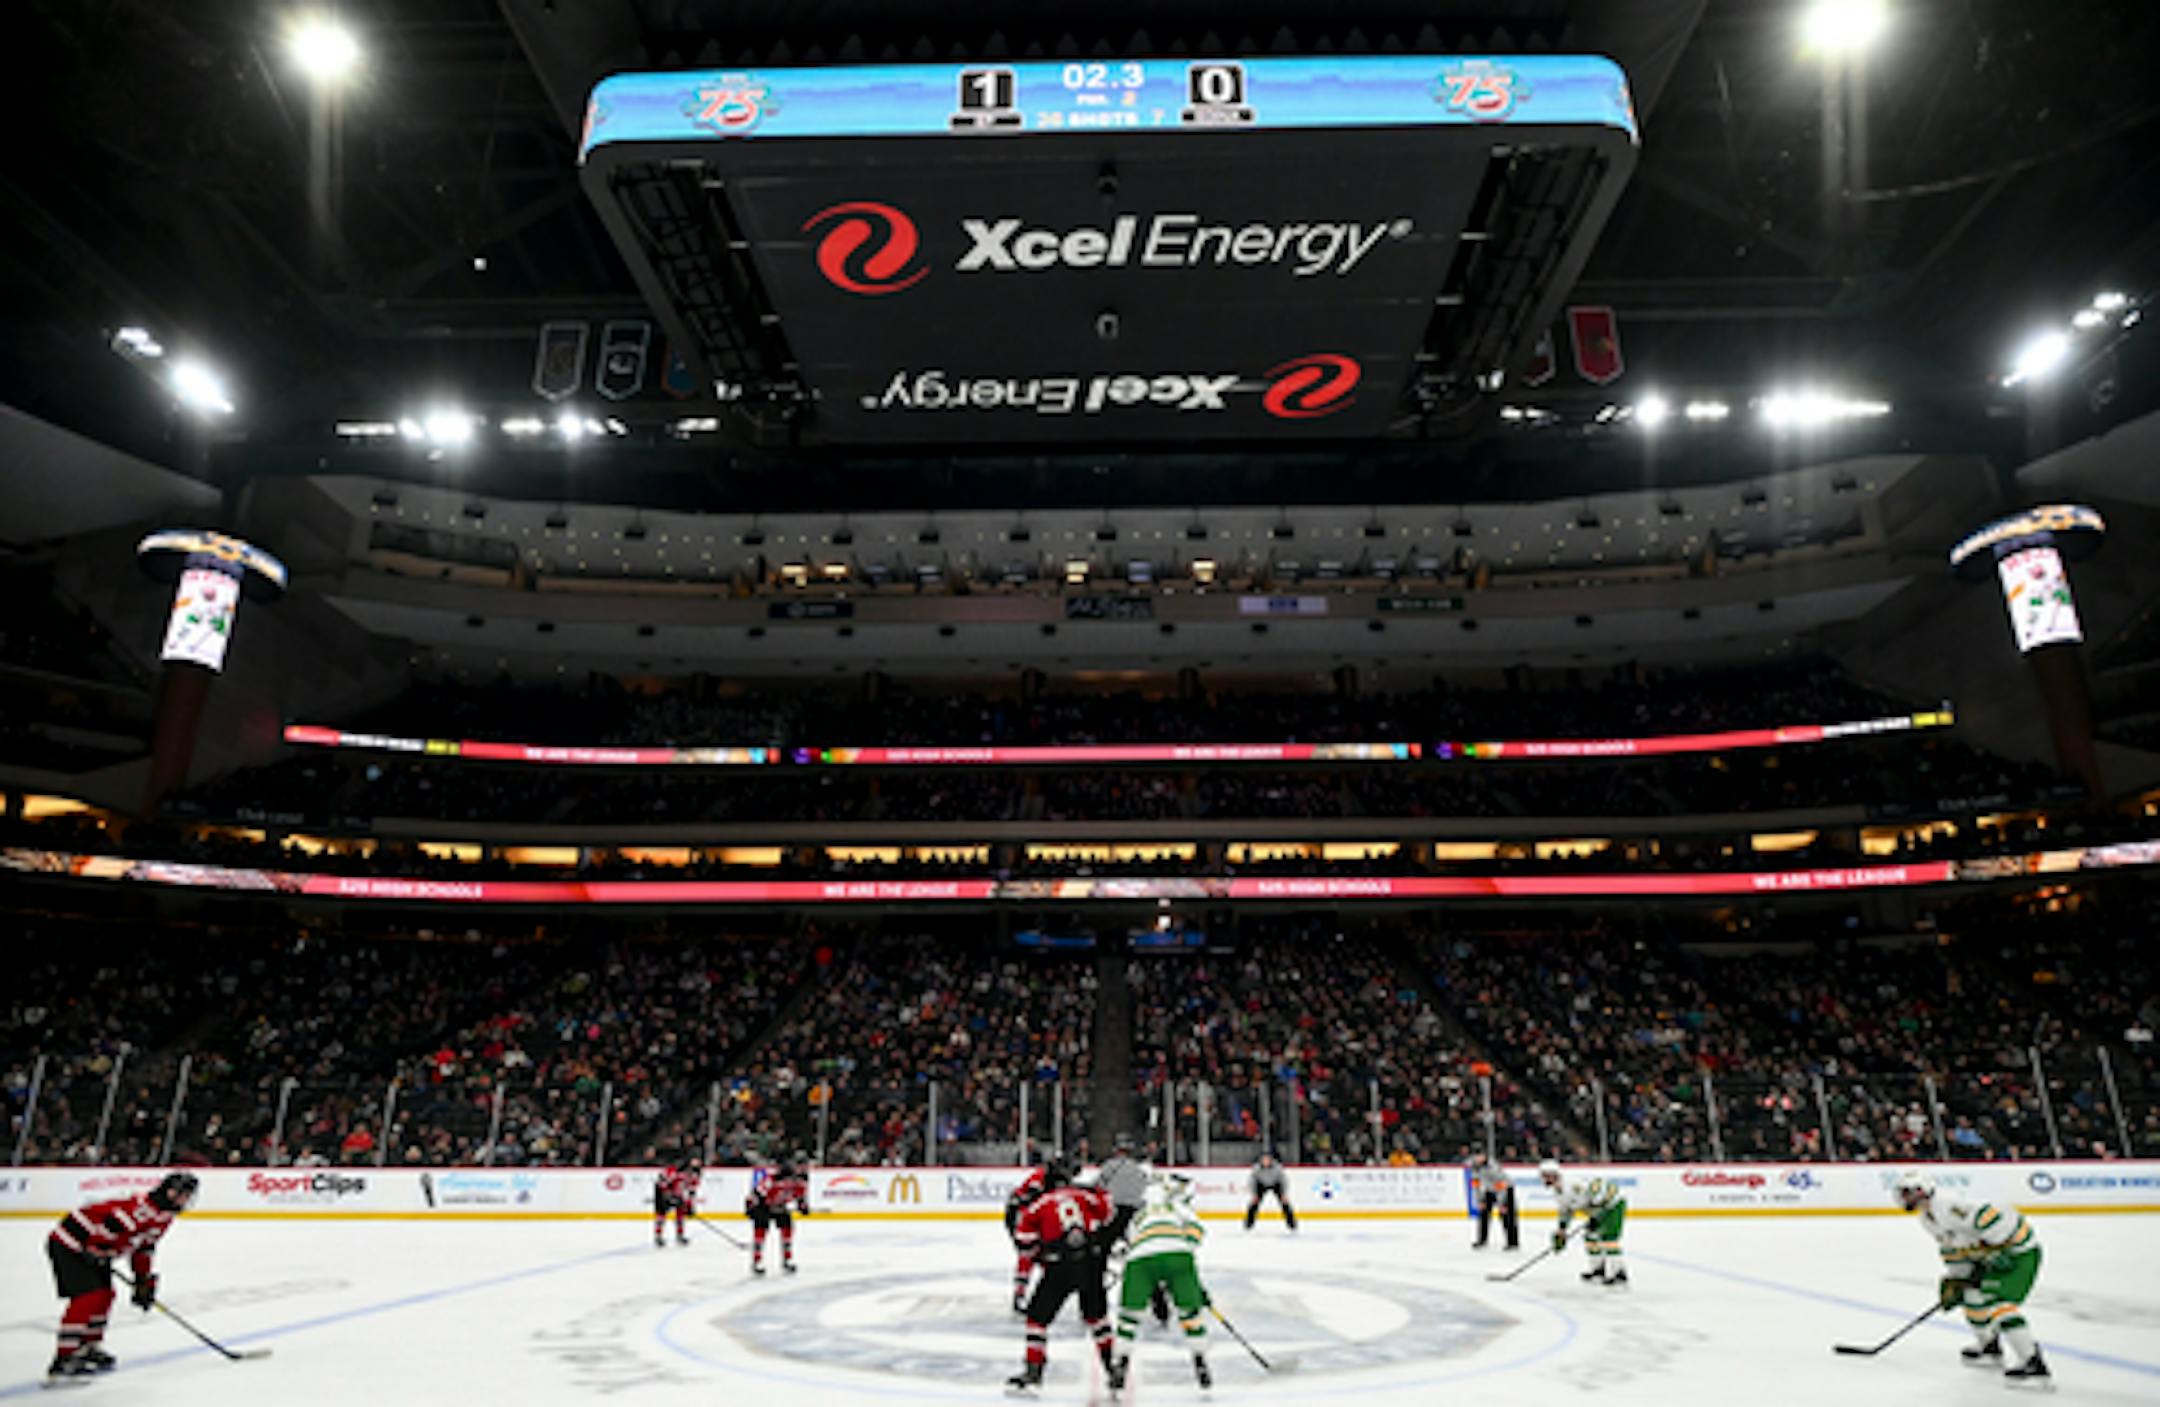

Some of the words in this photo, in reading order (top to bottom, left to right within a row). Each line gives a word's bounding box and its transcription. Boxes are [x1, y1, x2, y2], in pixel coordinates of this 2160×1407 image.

[972, 73, 998, 107] 1
[1062, 63, 1144, 89] 02.3
[1202, 67, 1234, 102] 0
[956, 217, 1137, 270] Xcel
[1141, 215, 1386, 275] Energy
[1085, 374, 1239, 411] Xcel
